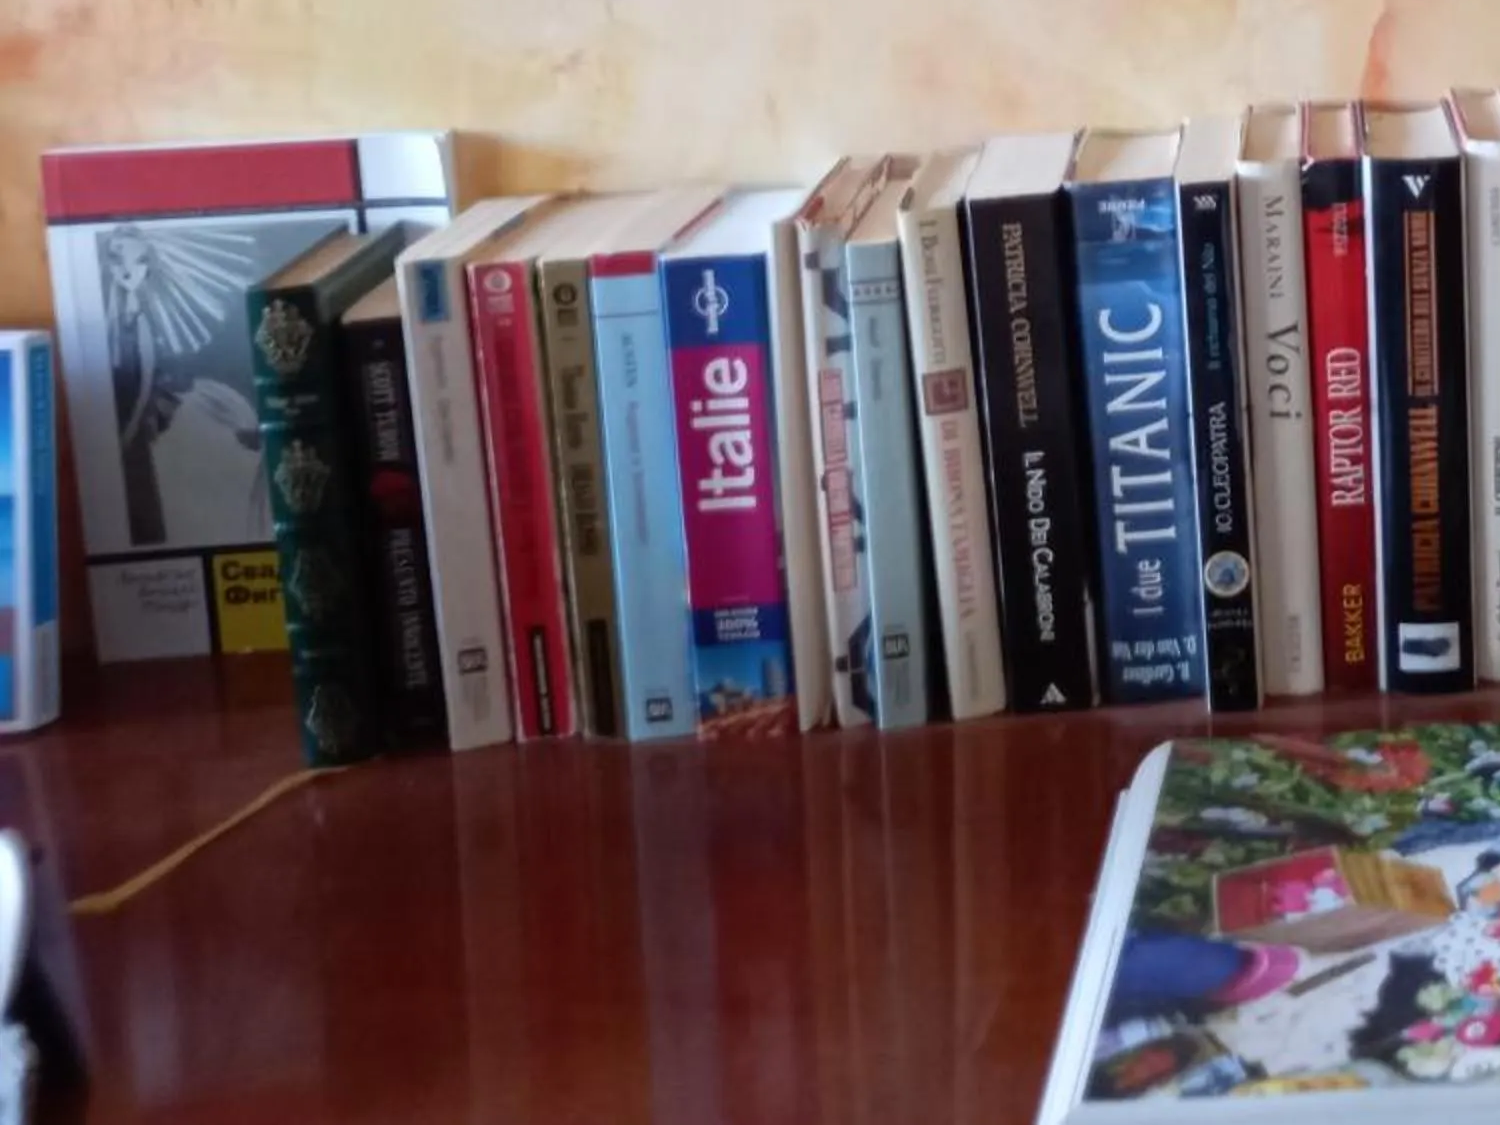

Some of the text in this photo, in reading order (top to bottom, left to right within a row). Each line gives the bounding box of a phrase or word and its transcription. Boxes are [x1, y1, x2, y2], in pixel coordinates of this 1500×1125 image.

[1002, 223, 1039, 428] PATRICIA CORNWELL
[1265, 320, 1303, 419] Voci
[690, 356, 757, 512] Italie
[1098, 302, 1177, 554] TITANIC
[1208, 401, 1232, 509] CLEOPATRA
[1326, 346, 1365, 506] RAPTOR RED
[1408, 404, 1439, 514] CORNWELL
[1131, 558, 1164, 602] due
[1343, 583, 1365, 664] BAKKER
